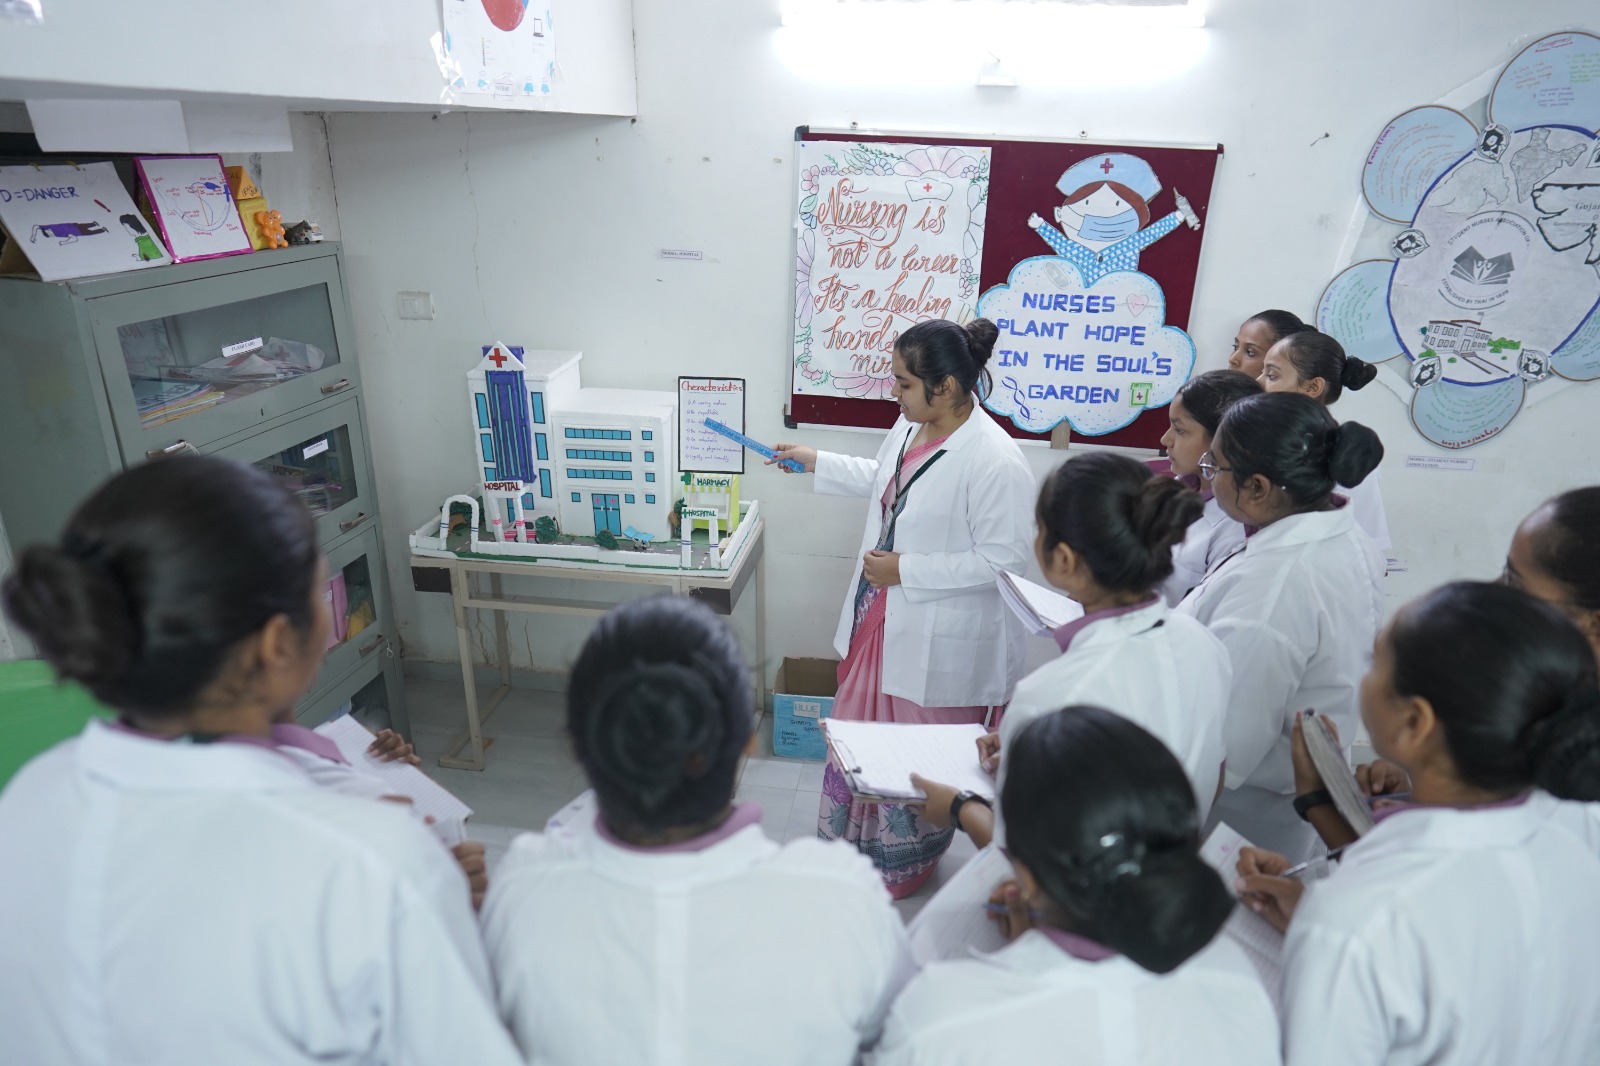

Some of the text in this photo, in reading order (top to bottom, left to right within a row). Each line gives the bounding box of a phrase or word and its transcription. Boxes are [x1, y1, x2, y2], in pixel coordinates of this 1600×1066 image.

[817, 178, 949, 248] Nursing is
[1447, 225, 1471, 246] STUDENT
[1471, 218, 1494, 228] NURSES
[827, 236, 871, 269] not
[874, 247, 897, 271] a
[852, 289, 880, 309] a
[880, 271, 952, 320] healing
[1022, 292, 1116, 313] NURSES
[1441, 278, 1466, 303] ESTABLISHED
[821, 314, 898, 353] hands
[997, 318, 1146, 346] PLANT HOPE
[998, 350, 1172, 376] IN THE SOUL'S
[1028, 384, 1120, 404] GARDEN
[484, 481, 521, 491] HOSPITAL
[688, 509, 717, 518] HOSPITAL
[795, 703, 819, 713] BLUE
